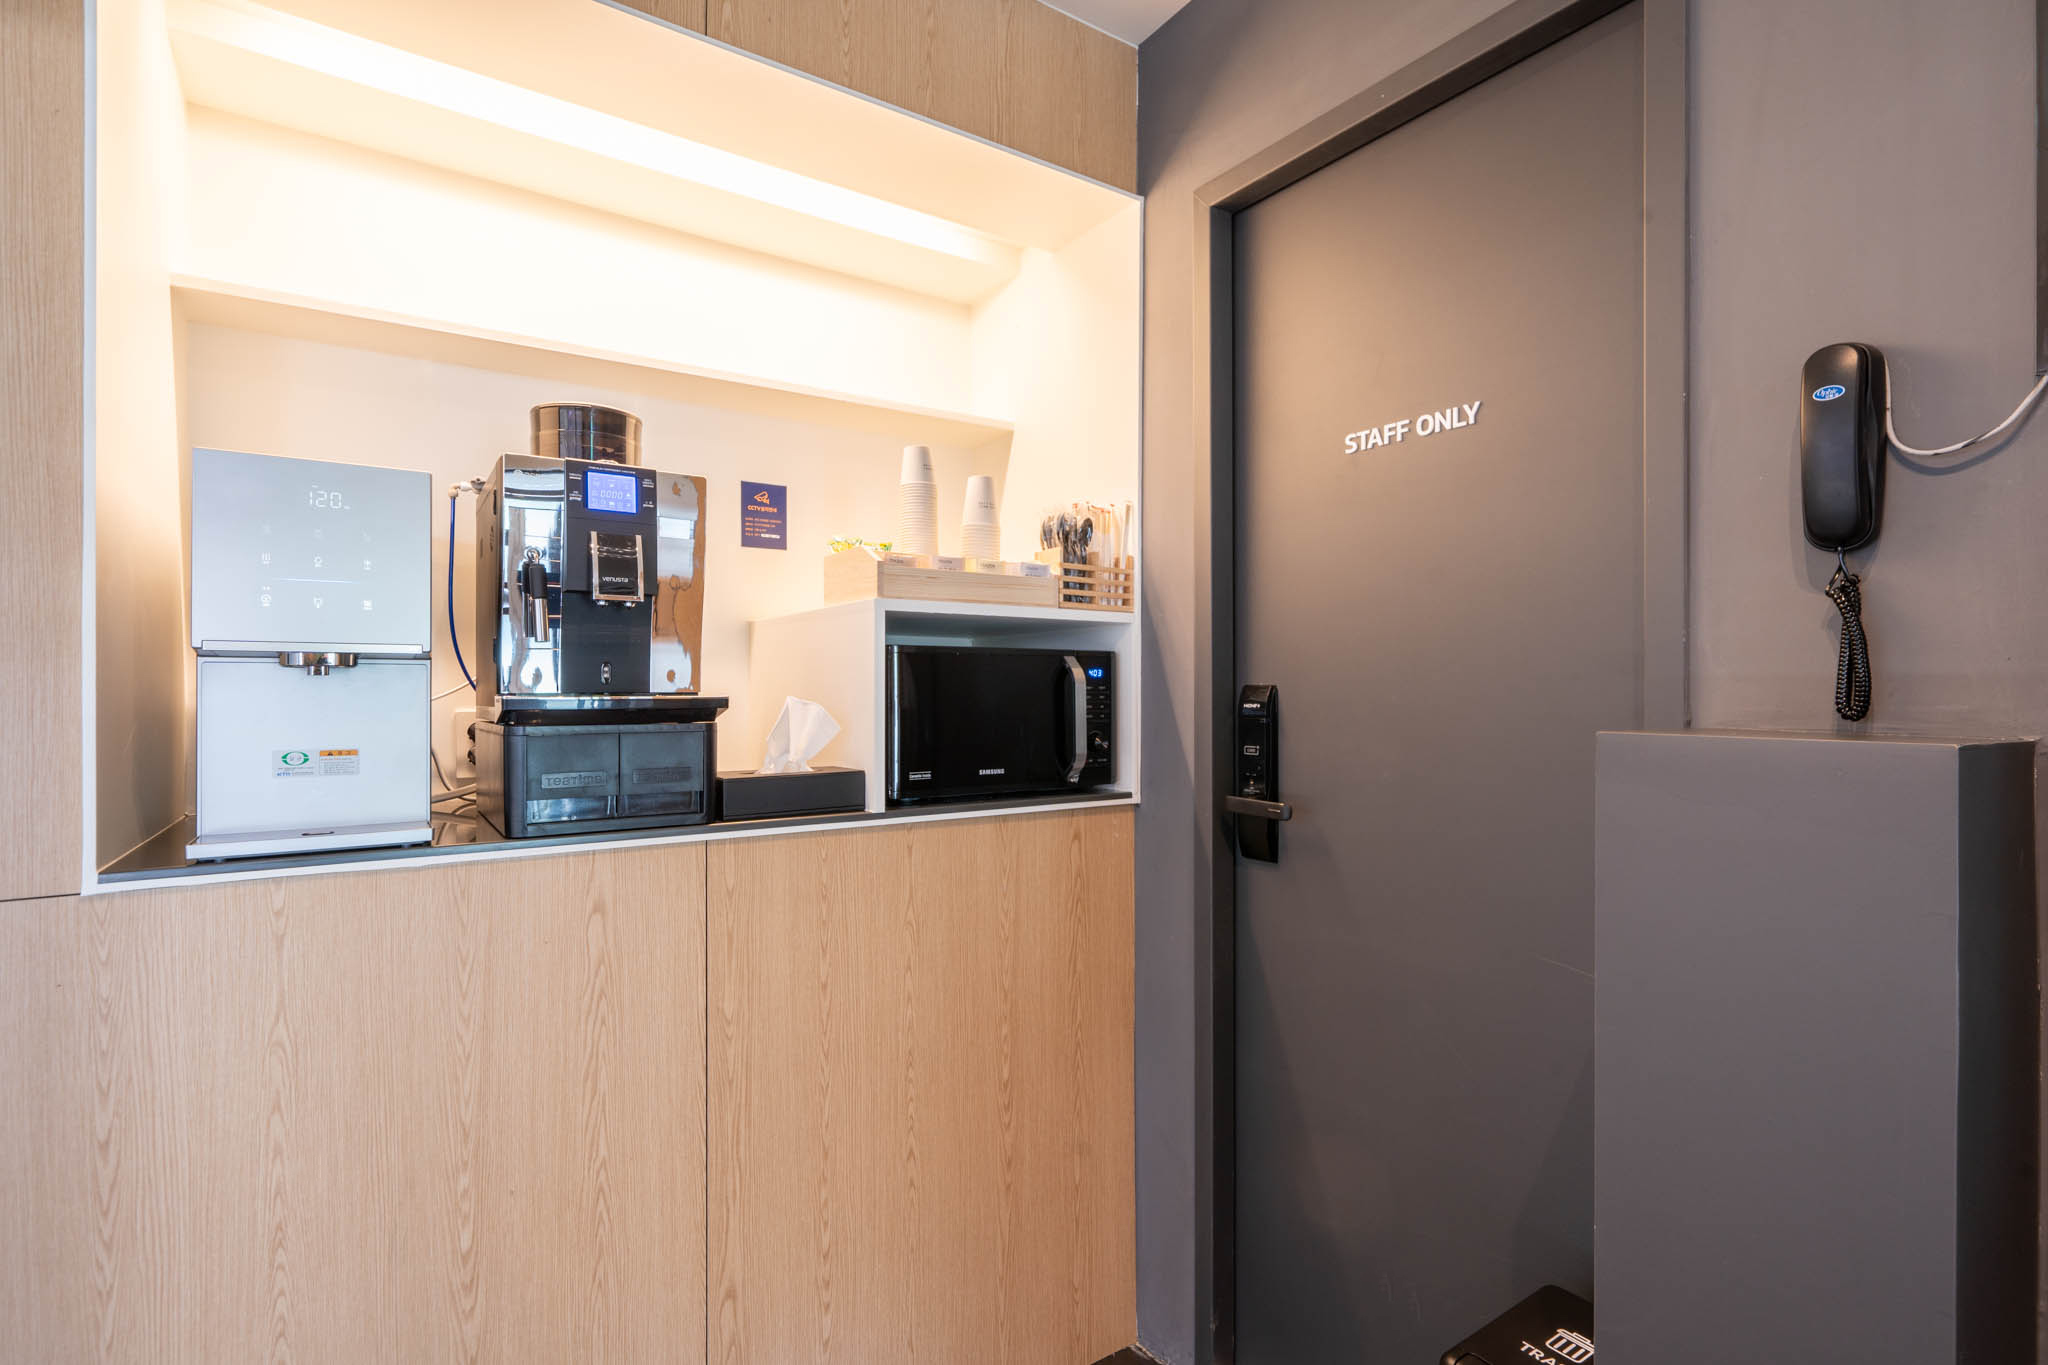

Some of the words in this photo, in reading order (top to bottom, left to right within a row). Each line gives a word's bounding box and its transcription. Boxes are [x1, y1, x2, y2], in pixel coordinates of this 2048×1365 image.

[1344, 419, 1411, 454] STAFF
[1416, 400, 1482, 436] ONLY
[310, 490, 341, 508] 120
[1520, 1341, 1566, 1365] TRA
